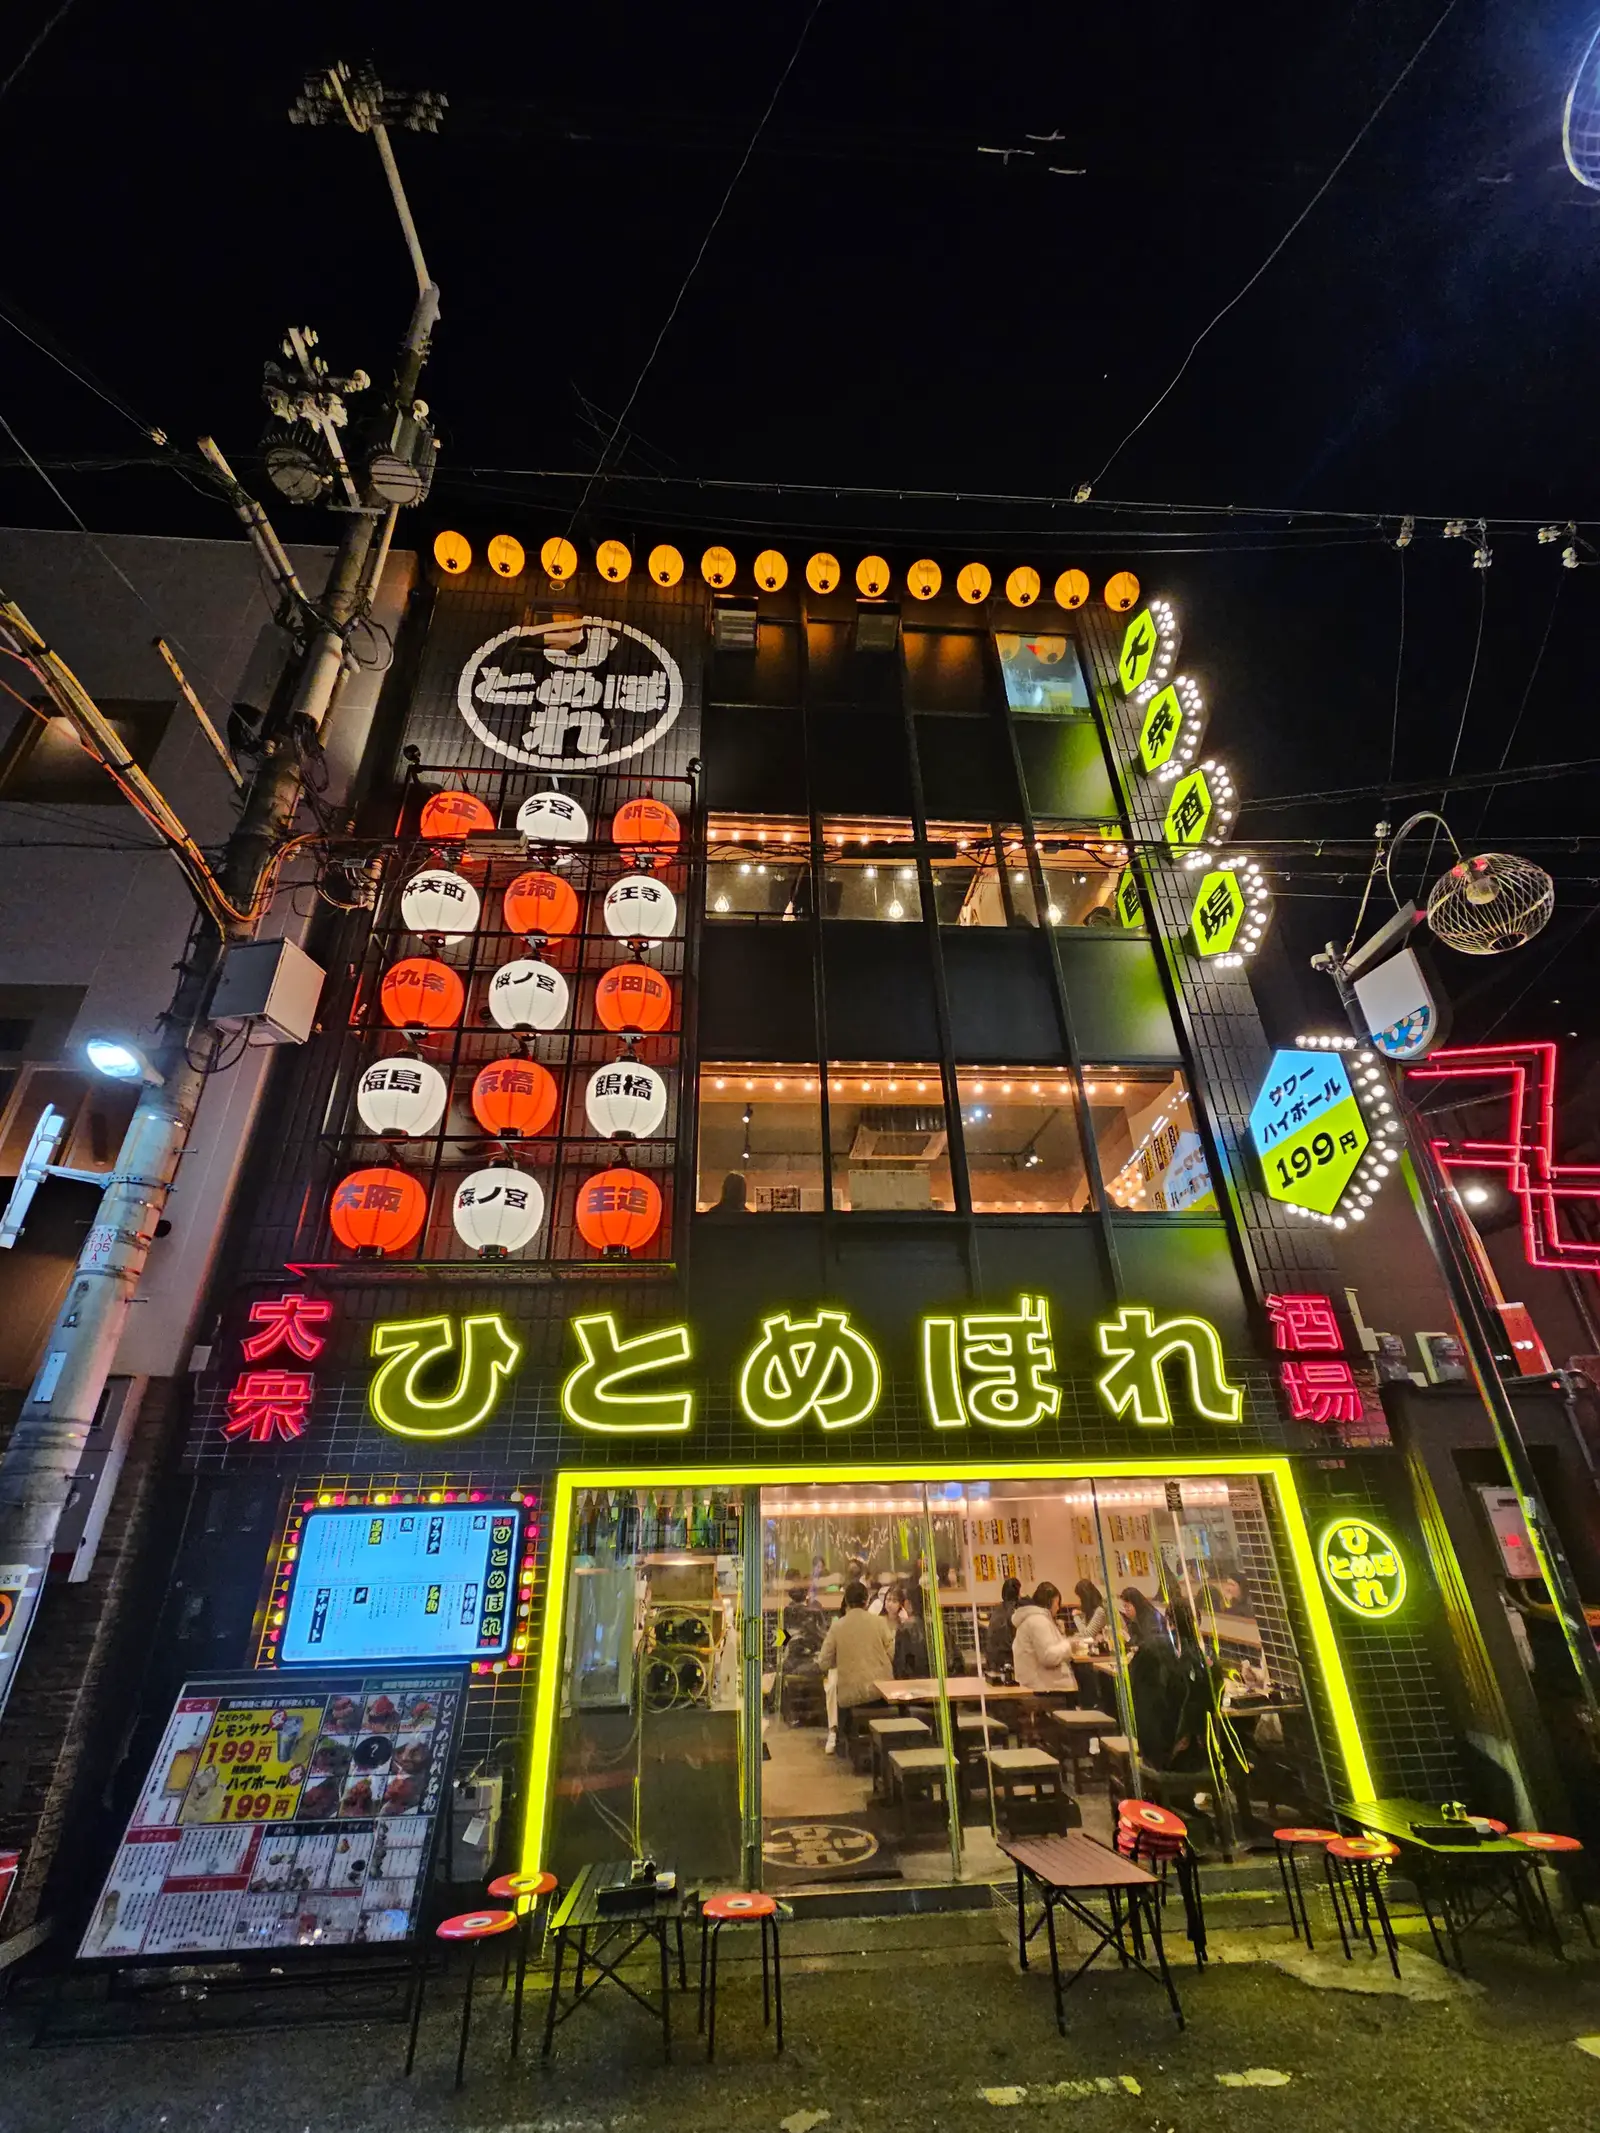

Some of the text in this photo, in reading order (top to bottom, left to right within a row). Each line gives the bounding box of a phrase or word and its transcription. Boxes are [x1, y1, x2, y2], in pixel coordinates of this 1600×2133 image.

[425, 797, 478, 821] 大正
[507, 878, 556, 900] 天満
[607, 886, 661, 910] 天王寺
[362, 1068, 422, 1094] 福島
[479, 1070, 534, 1096] 京橋
[595, 1073, 653, 1101] 鶴橋
[1268, 1067, 1315, 1107] サワー
[1264, 1077, 1342, 1144] ハイボール
[1276, 1129, 1360, 1190] 199円
[335, 1184, 403, 1213] 大阪
[221, 1294, 333, 1443] 大衆
[368, 1294, 1246, 1438] ひとめぼれ
[1266, 1293, 1364, 1424] 酒場
[428, 1517, 443, 1554] サラダ
[481, 1526, 512, 1637] ひとめぼれ
[426, 1585, 440, 1613] 名物
[311, 1590, 330, 1642] デザート
[184, 1702, 211, 1711] ビール
[212, 1722, 283, 1738] レモンサワー
[206, 1740, 273, 1765] 199円
[226, 1775, 290, 1791] ハイボール
[220, 1793, 291, 1820] 199円
